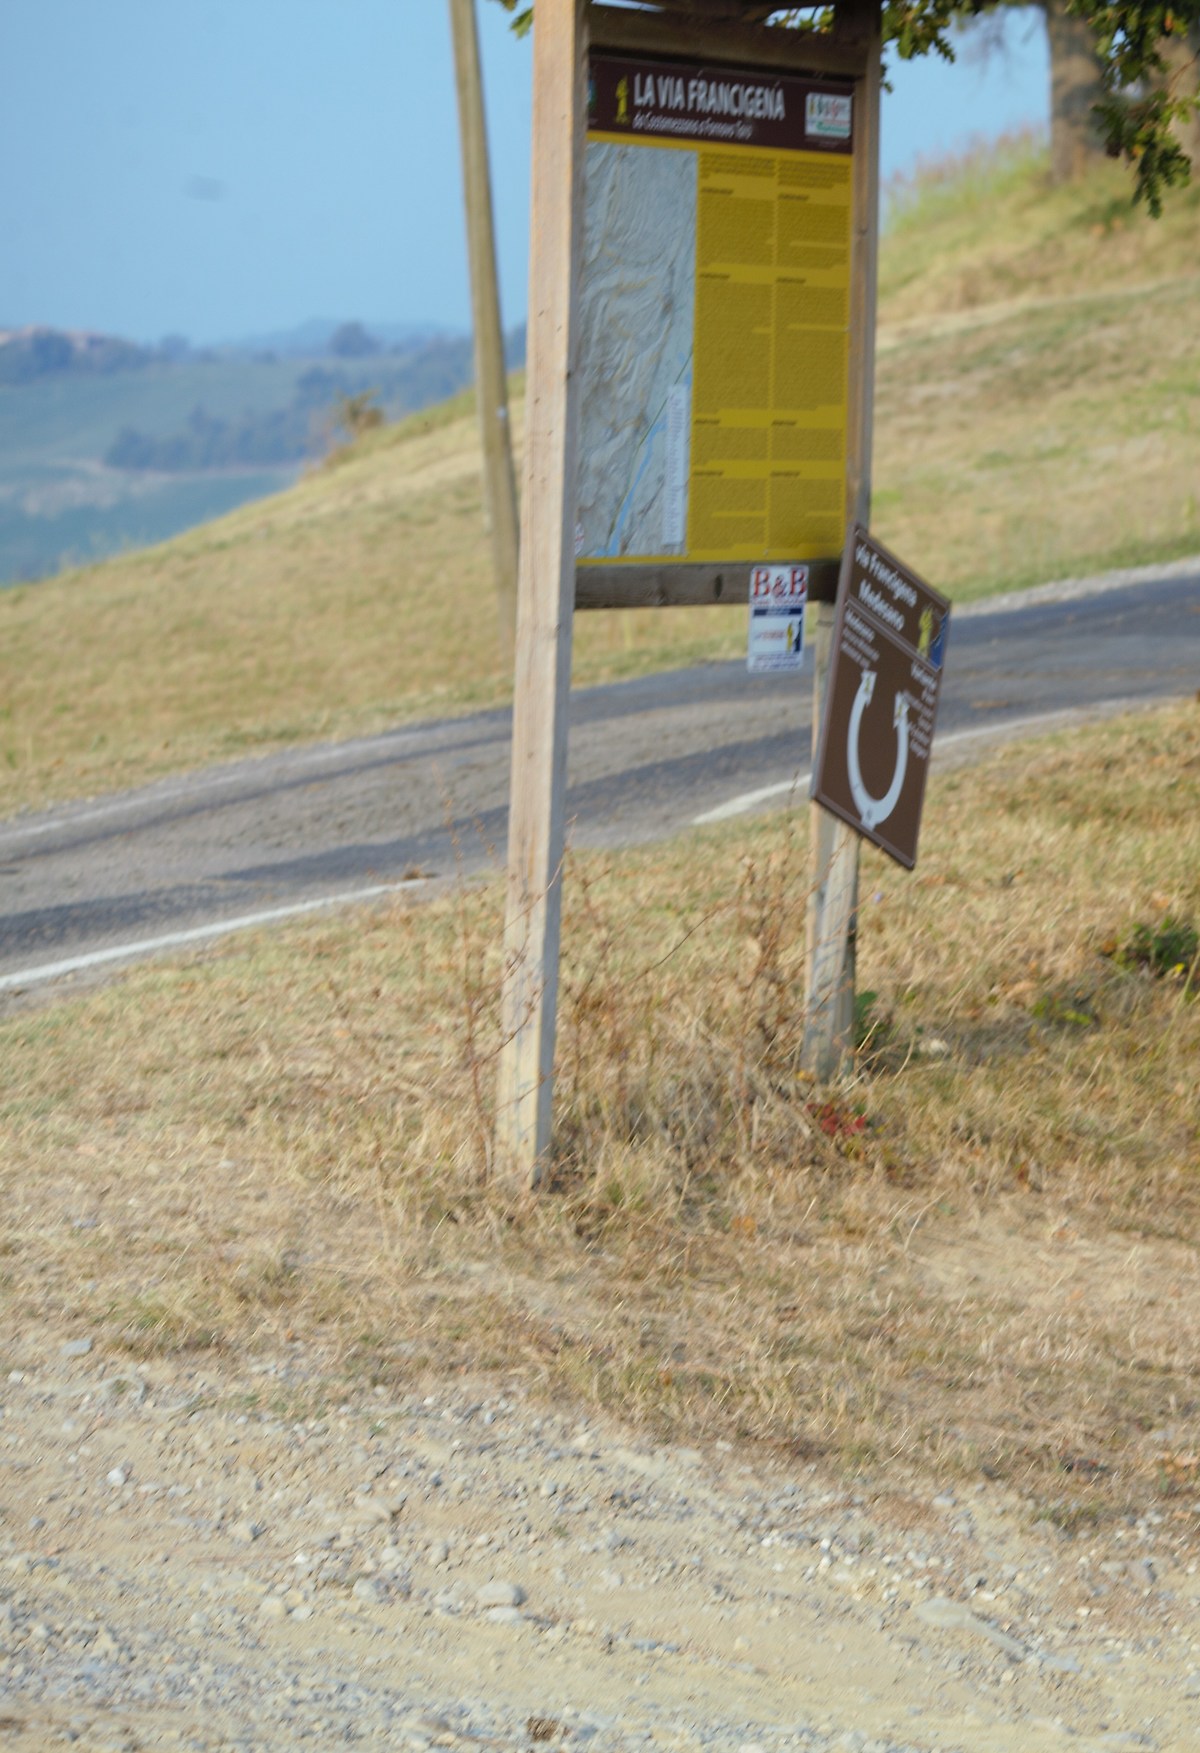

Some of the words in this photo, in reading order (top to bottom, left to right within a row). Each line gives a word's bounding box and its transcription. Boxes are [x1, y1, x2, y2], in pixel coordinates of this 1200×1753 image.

[634, 73, 656, 108] LA
[658, 76, 686, 111] VIA
[686, 79, 786, 122] FRANCIGENA
[753, 568, 806, 598] B&B
